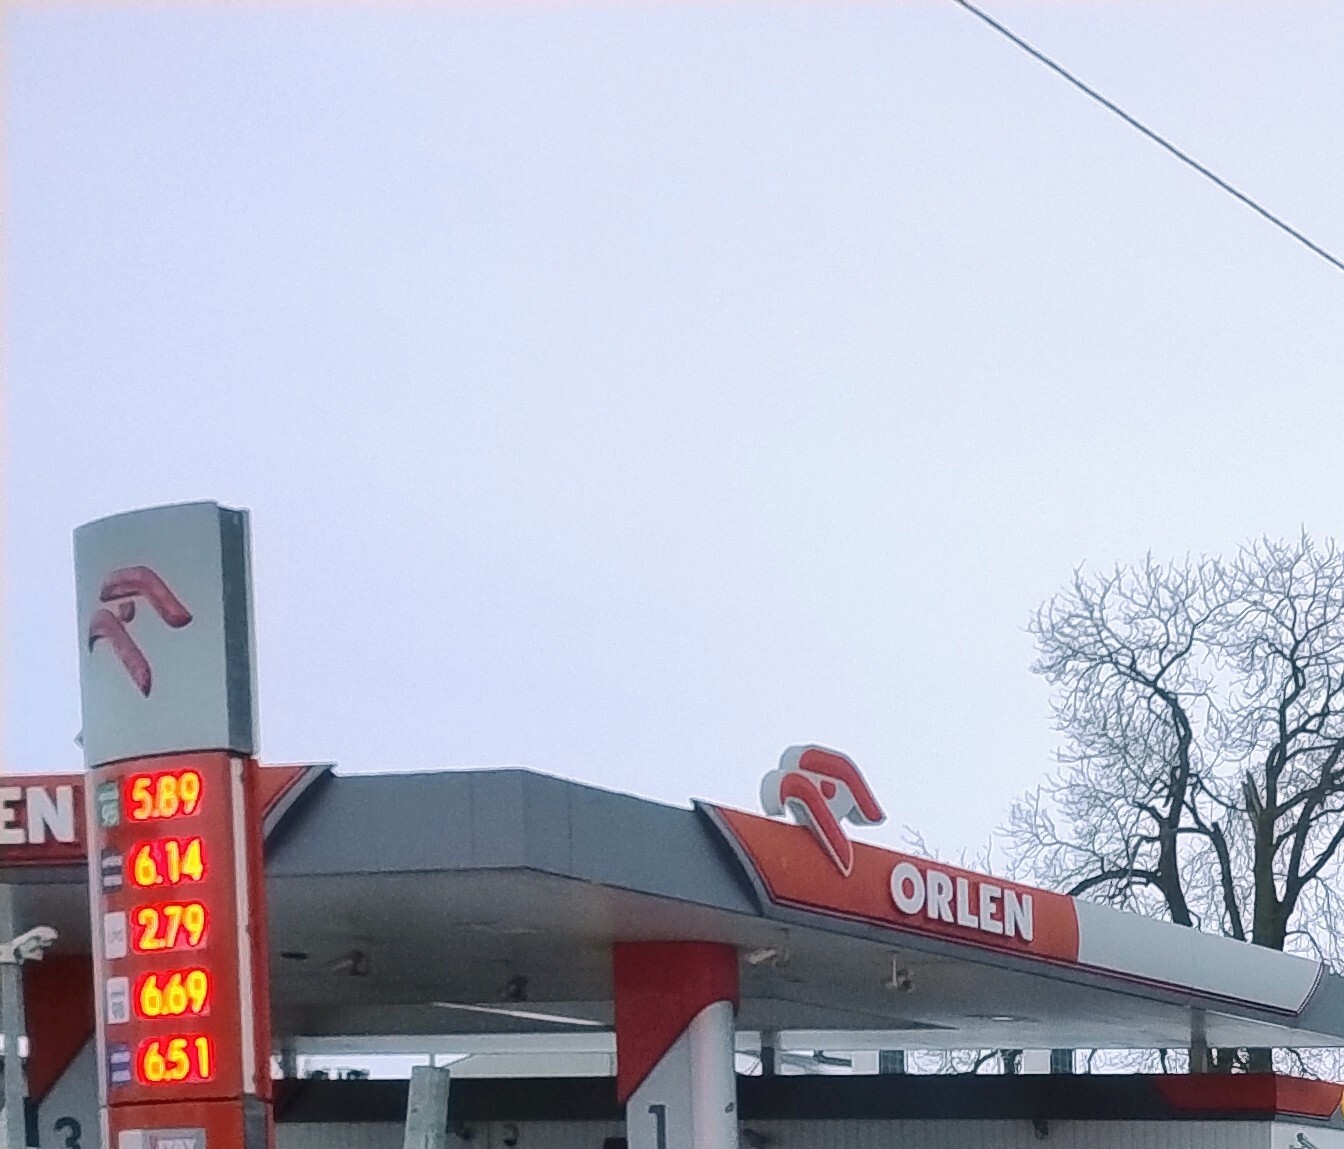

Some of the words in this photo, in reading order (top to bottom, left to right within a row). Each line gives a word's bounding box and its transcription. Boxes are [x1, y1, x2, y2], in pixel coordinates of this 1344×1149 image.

[132, 772, 200, 820] 5.89
[134, 838, 204, 886] 6.14
[890, 861, 1034, 942] ORLEN
[138, 903, 205, 950] 2.79
[140, 970, 208, 1016] 6.69
[143, 1037, 209, 1082] 6.51
